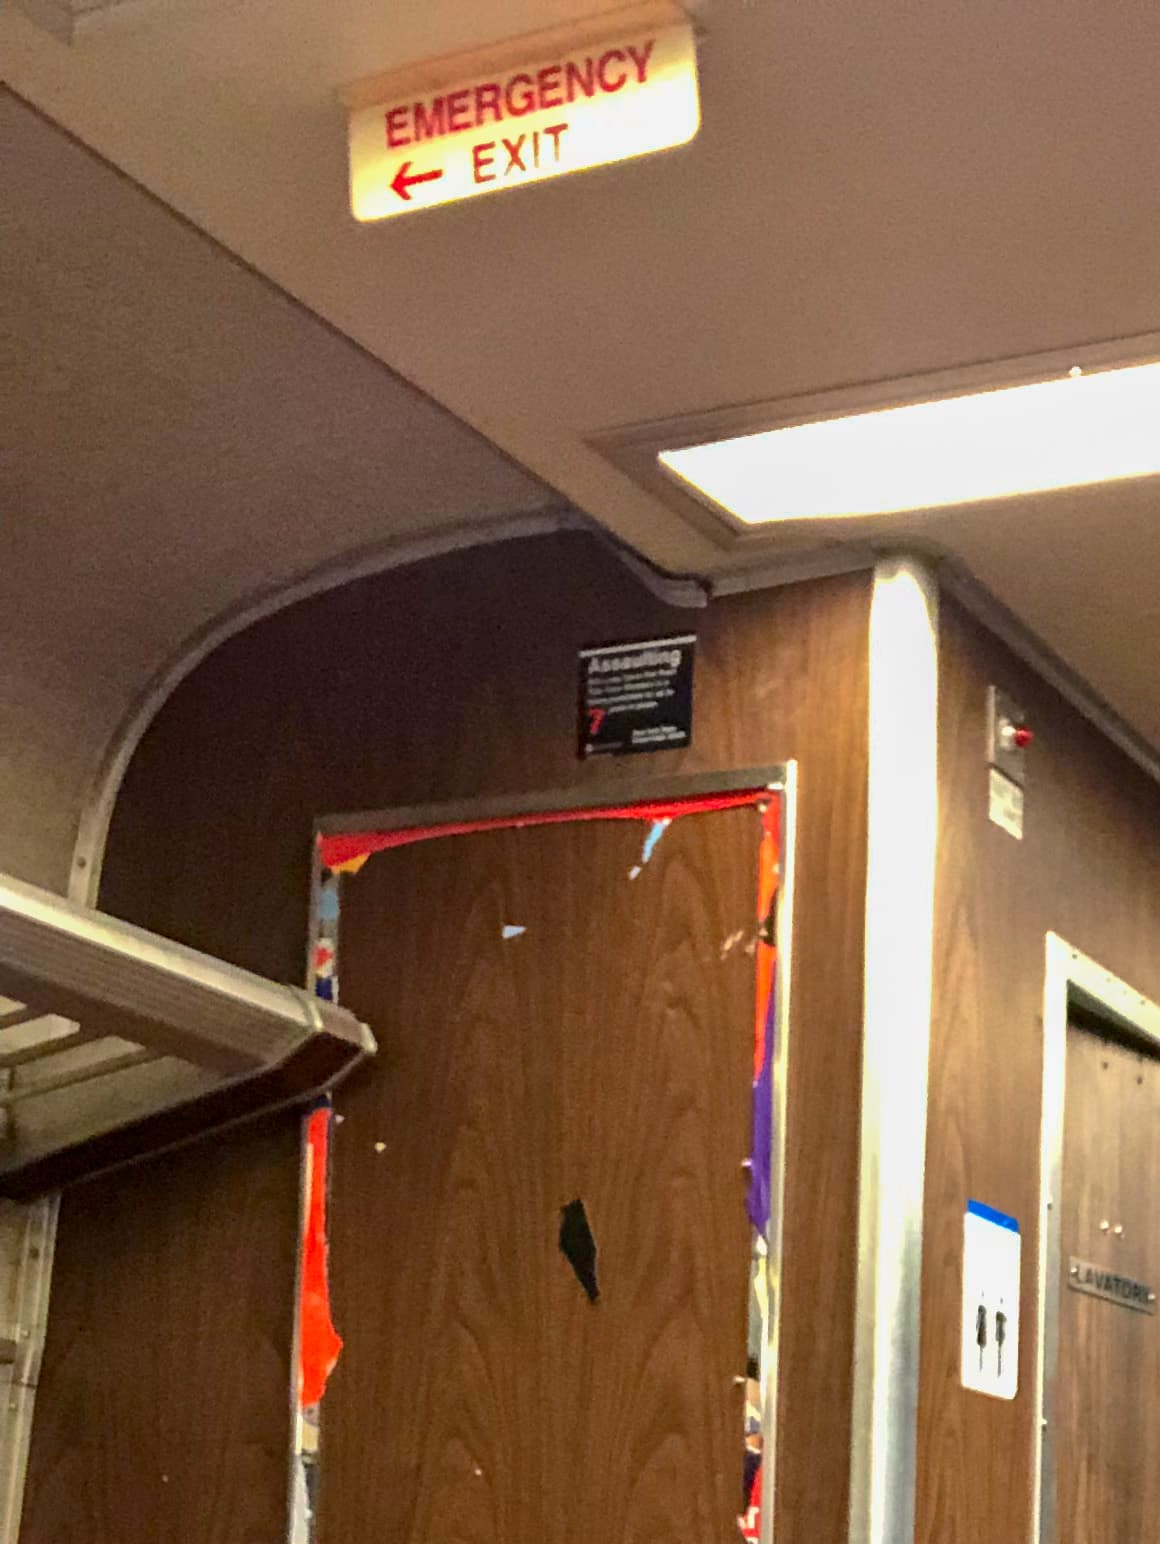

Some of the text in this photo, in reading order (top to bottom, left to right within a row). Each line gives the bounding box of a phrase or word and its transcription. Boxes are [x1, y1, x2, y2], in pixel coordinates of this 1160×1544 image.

[384, 40, 656, 150] EMERGENCY
[472, 123, 569, 184] EXIT
[588, 708, 605, 735] 7
